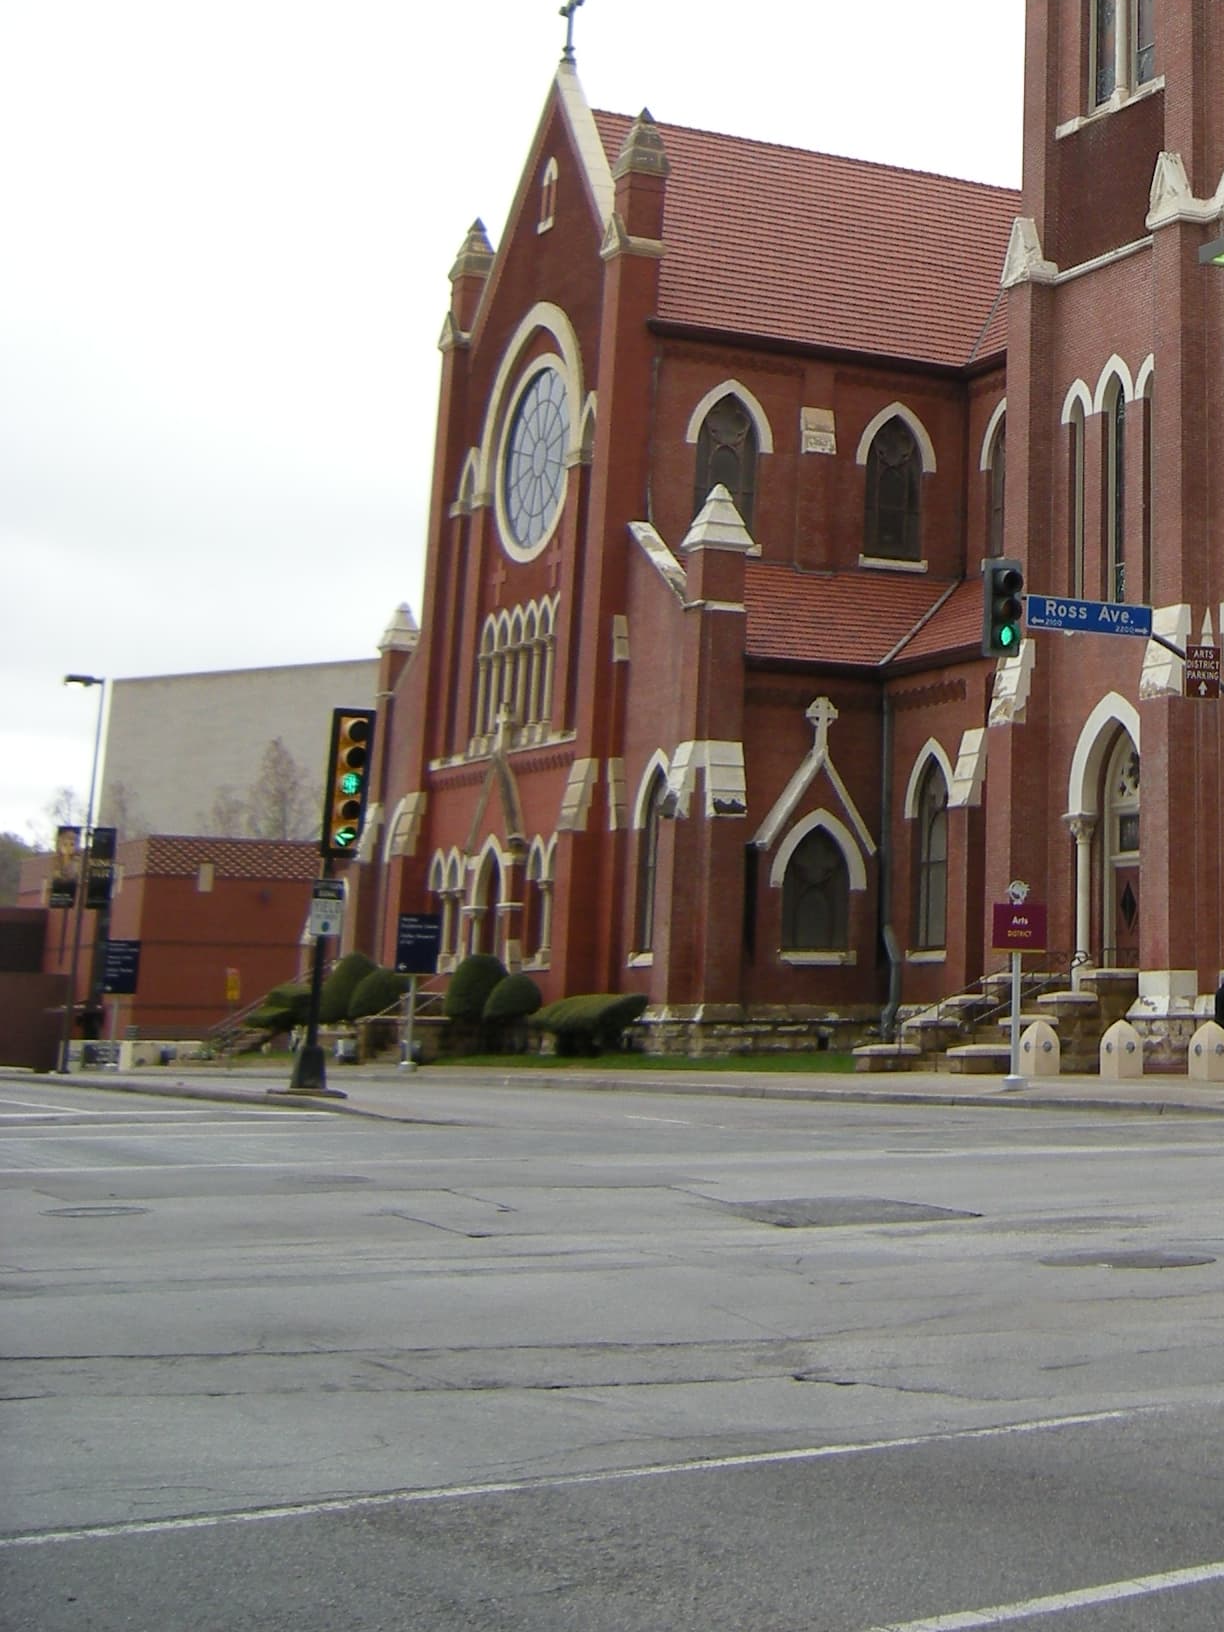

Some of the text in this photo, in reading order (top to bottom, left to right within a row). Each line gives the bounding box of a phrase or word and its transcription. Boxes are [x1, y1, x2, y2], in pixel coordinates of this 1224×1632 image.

[1045, 600, 1134, 624] Ross Ave.
[1045, 618, 1063, 627] 2100
[1115, 625, 1134, 634] 2200
[1193, 649, 1214, 659] ARTS
[1187, 660, 1219, 670] DISTRICT
[1187, 670, 1219, 680] PARKING
[1012, 916, 1028, 925] Arts
